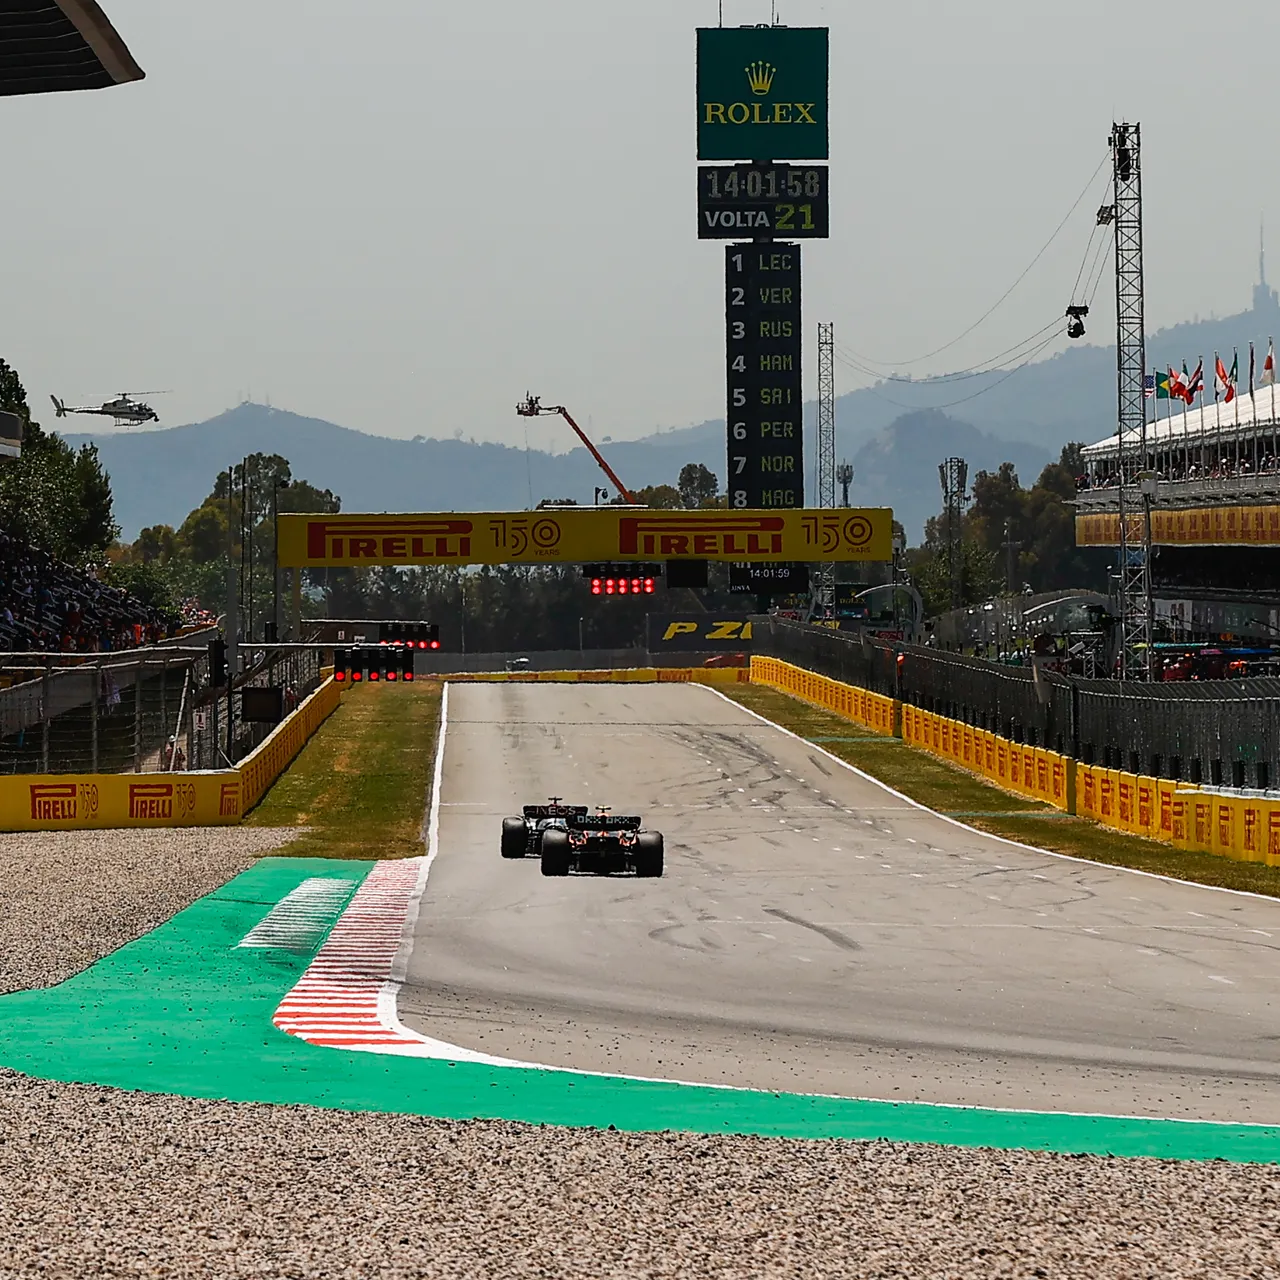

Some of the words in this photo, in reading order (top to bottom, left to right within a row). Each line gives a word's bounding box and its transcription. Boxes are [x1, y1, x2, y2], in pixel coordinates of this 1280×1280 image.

[703, 102, 817, 124] ROLEX
[706, 170, 820, 198] 14:01:58
[704, 211, 770, 227] VOLTA
[774, 204, 816, 230] 21
[731, 254, 743, 272] 1
[759, 254, 792, 270] LEC
[731, 287, 745, 305] 2
[759, 288, 792, 303] VER
[732, 321, 746, 339] 3
[759, 321, 792, 337] RUS
[731, 354, 746, 372] 4
[760, 354, 793, 371] HAM
[733, 388, 747, 407] 5
[760, 388, 792, 404] SAI
[733, 422, 747, 440] 6
[760, 422, 794, 438] PER
[733, 456, 747, 474] 7
[761, 456, 795, 472] NOR
[733, 489, 748, 508] 8
[761, 489, 795, 505] MAG
[307, 520, 472, 559] PIRELLI
[489, 518, 561, 556] 150
[619, 517, 785, 554] PIRELLI
[801, 516, 873, 553] 150
[534, 548, 561, 556] YEARS
[749, 568, 791, 578] 14:01:59
[662, 621, 699, 640] P
[30, 784, 77, 819] PIRELLI
[129, 784, 173, 818] PIRELLI
[536, 806, 577, 815] INEOS
